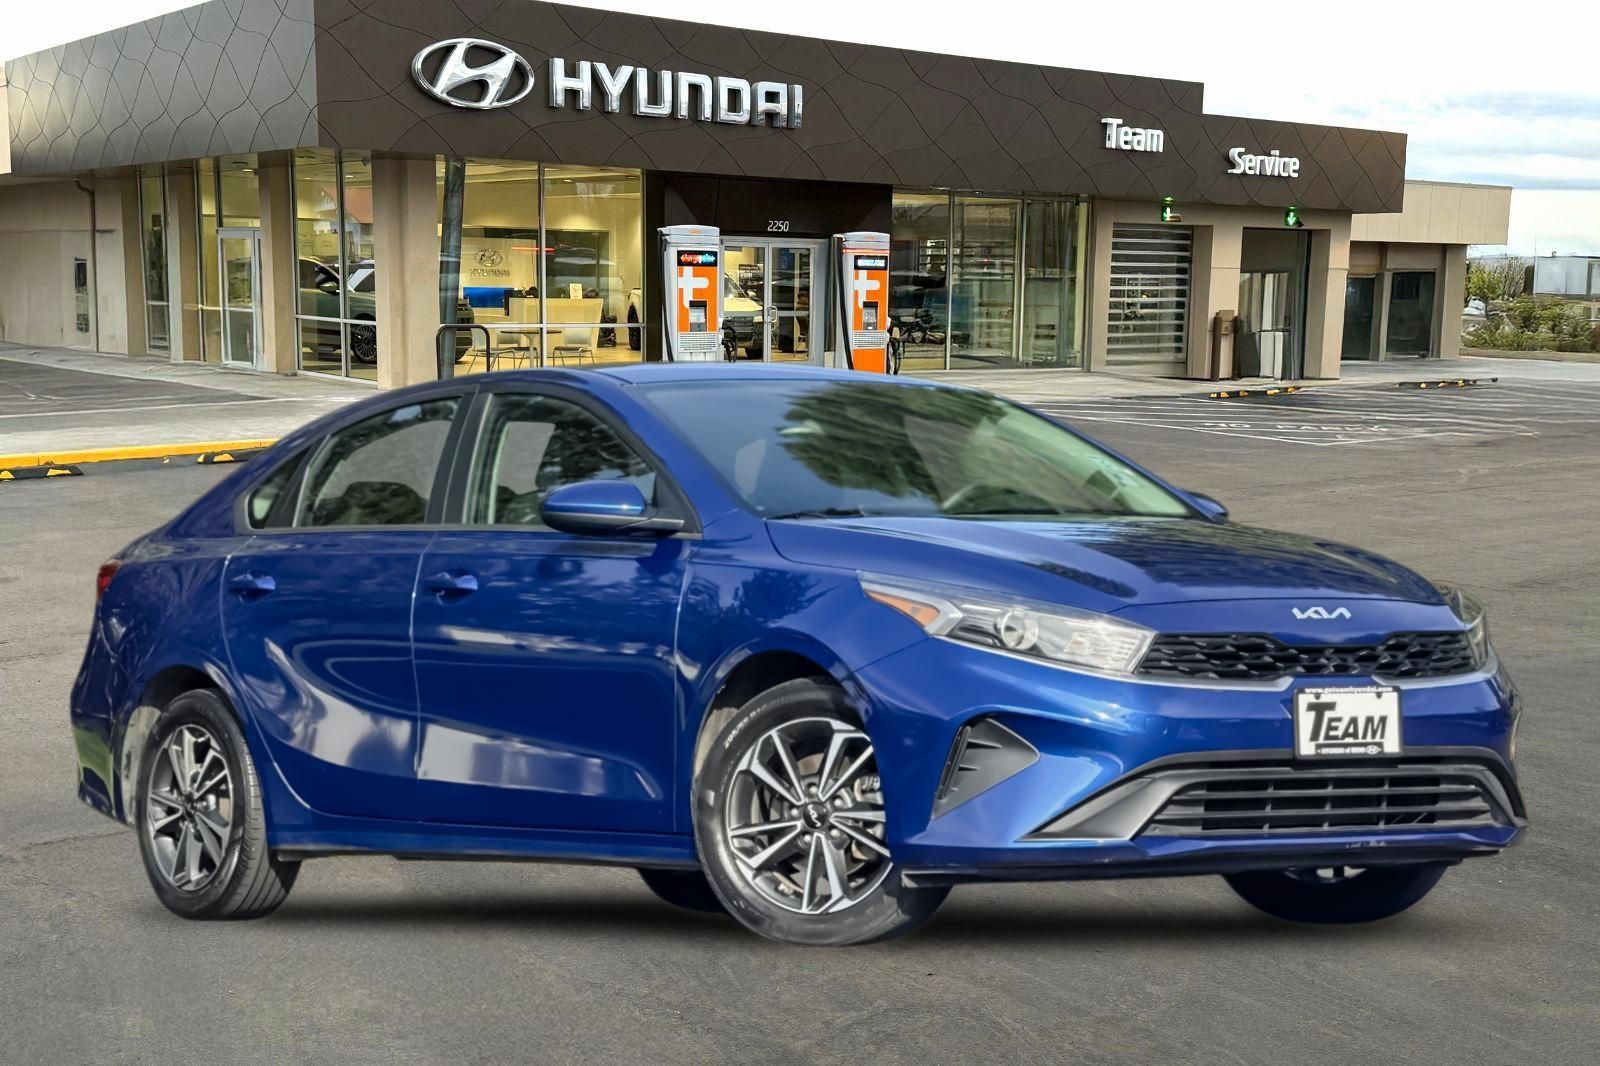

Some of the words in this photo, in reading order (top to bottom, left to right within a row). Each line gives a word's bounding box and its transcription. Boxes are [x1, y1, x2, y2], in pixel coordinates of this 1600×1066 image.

[548, 57, 803, 129] HYUNDAI
[1101, 117, 1164, 153] Team
[1227, 147, 1300, 178] Service
[767, 220, 790, 232] 2250
[1305, 701, 1388, 742] TEAM
